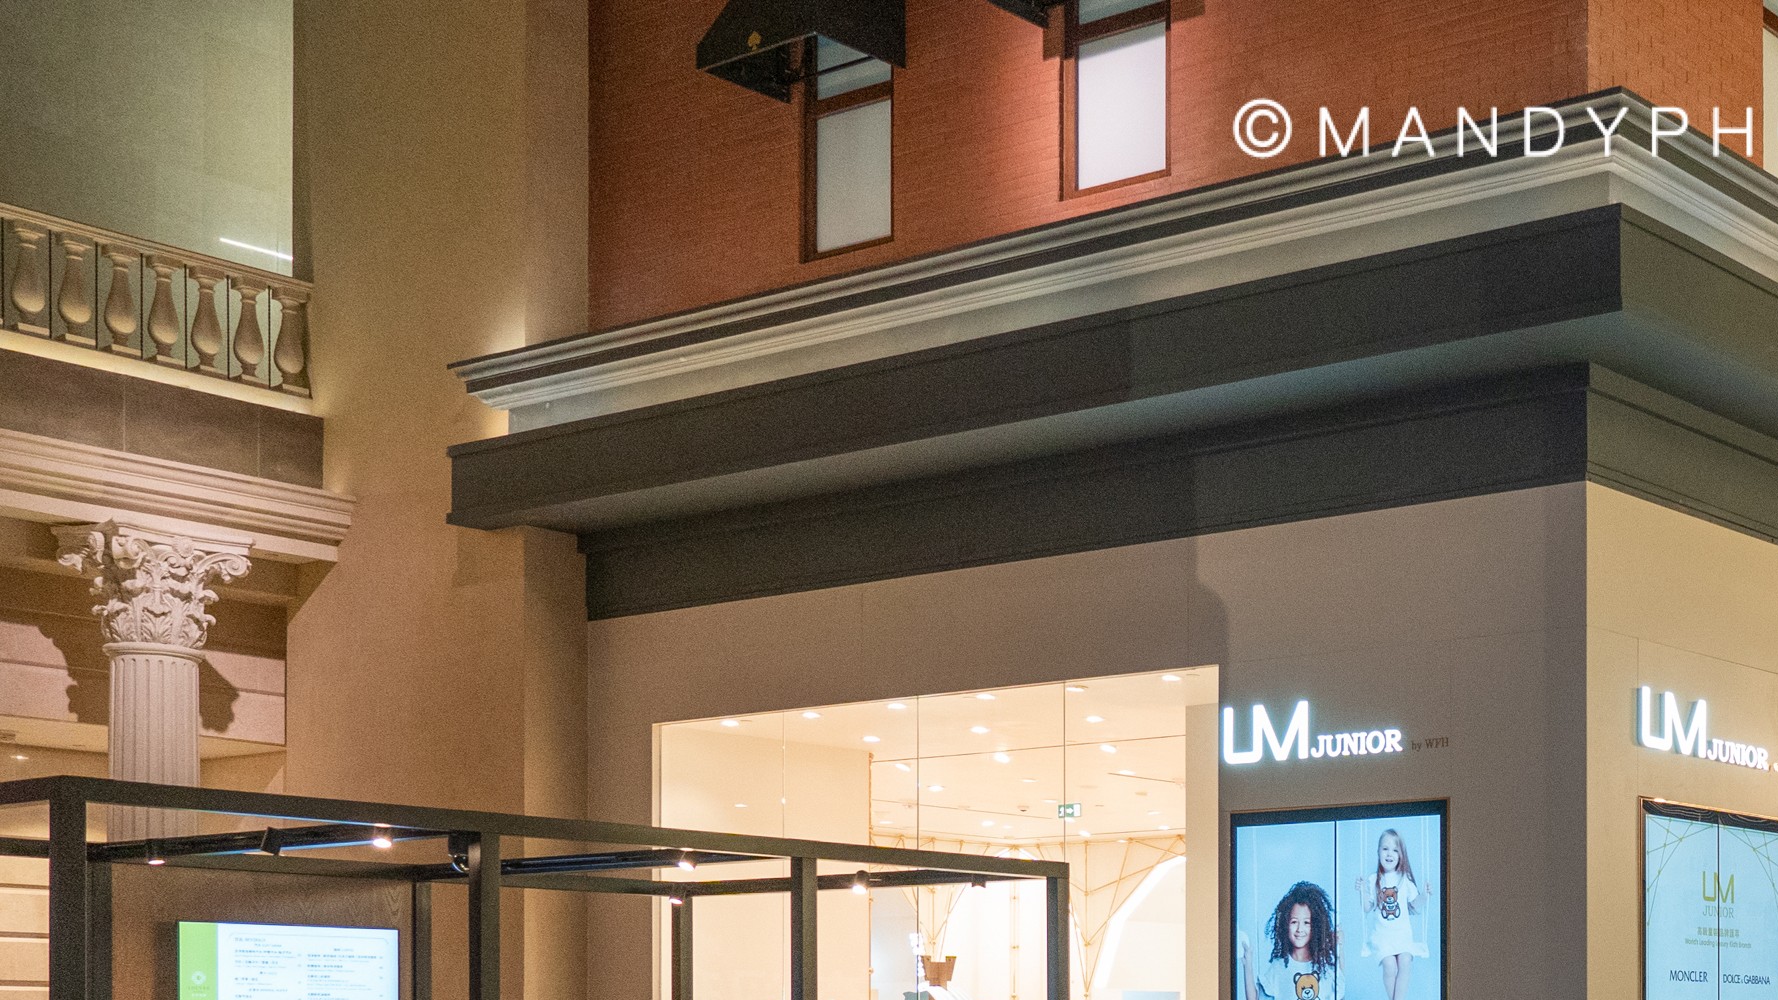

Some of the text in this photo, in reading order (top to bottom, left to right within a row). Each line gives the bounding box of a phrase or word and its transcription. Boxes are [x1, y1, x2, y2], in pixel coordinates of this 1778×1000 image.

[1223, 699, 1450, 765] LM JUNIOR by WFH
[1640, 684, 1769, 771] LM JUNIOR
[1702, 871, 1735, 904] LM
[1669, 970, 1709, 983] MONCLER
